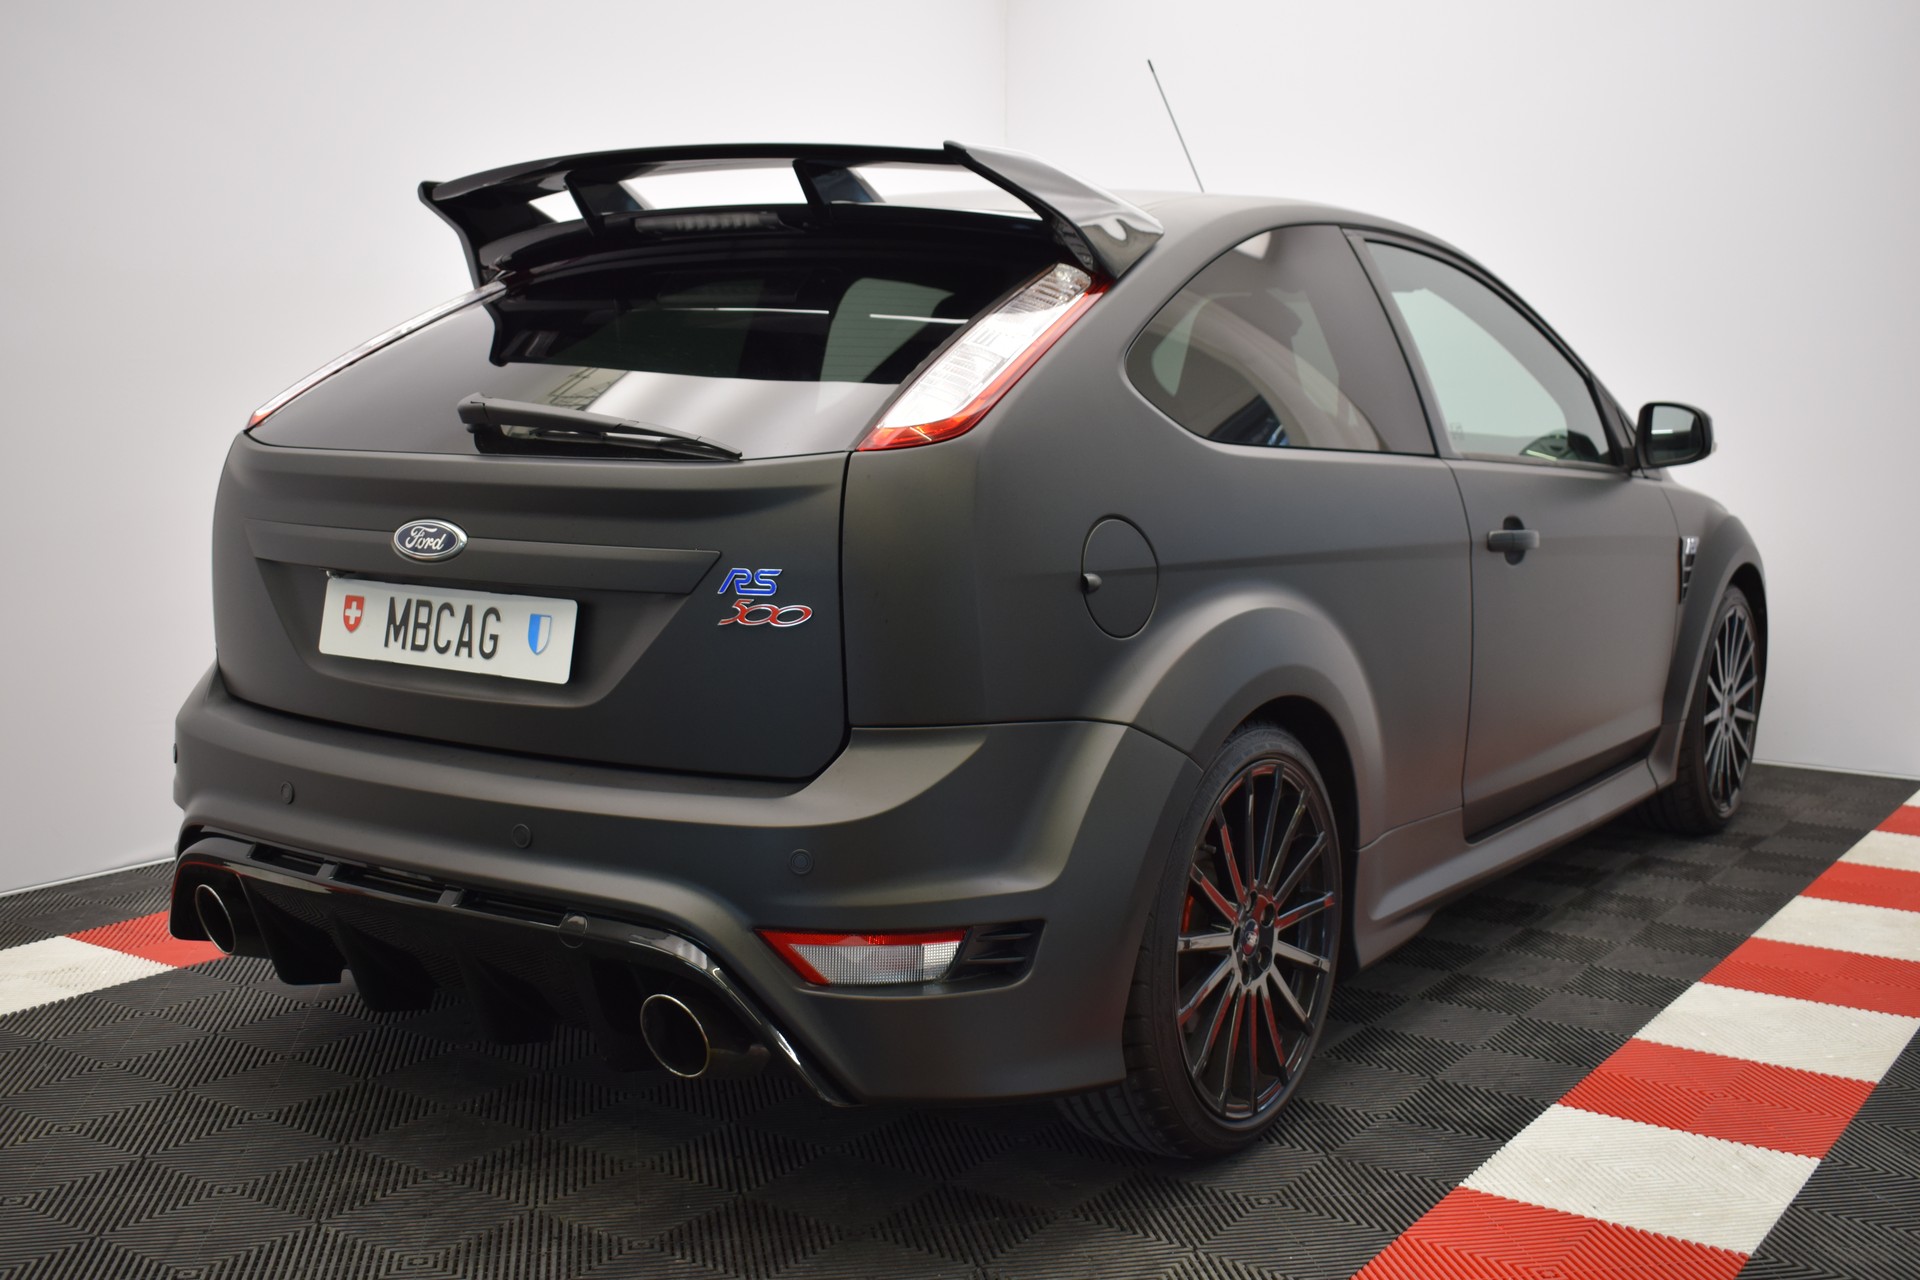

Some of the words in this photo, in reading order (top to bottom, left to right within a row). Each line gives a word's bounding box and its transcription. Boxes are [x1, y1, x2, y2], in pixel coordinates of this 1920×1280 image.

[405, 526, 447, 550] Ford
[717, 567, 782, 596] RS
[717, 598, 813, 627] 500
[384, 597, 501, 660] MBCAG
